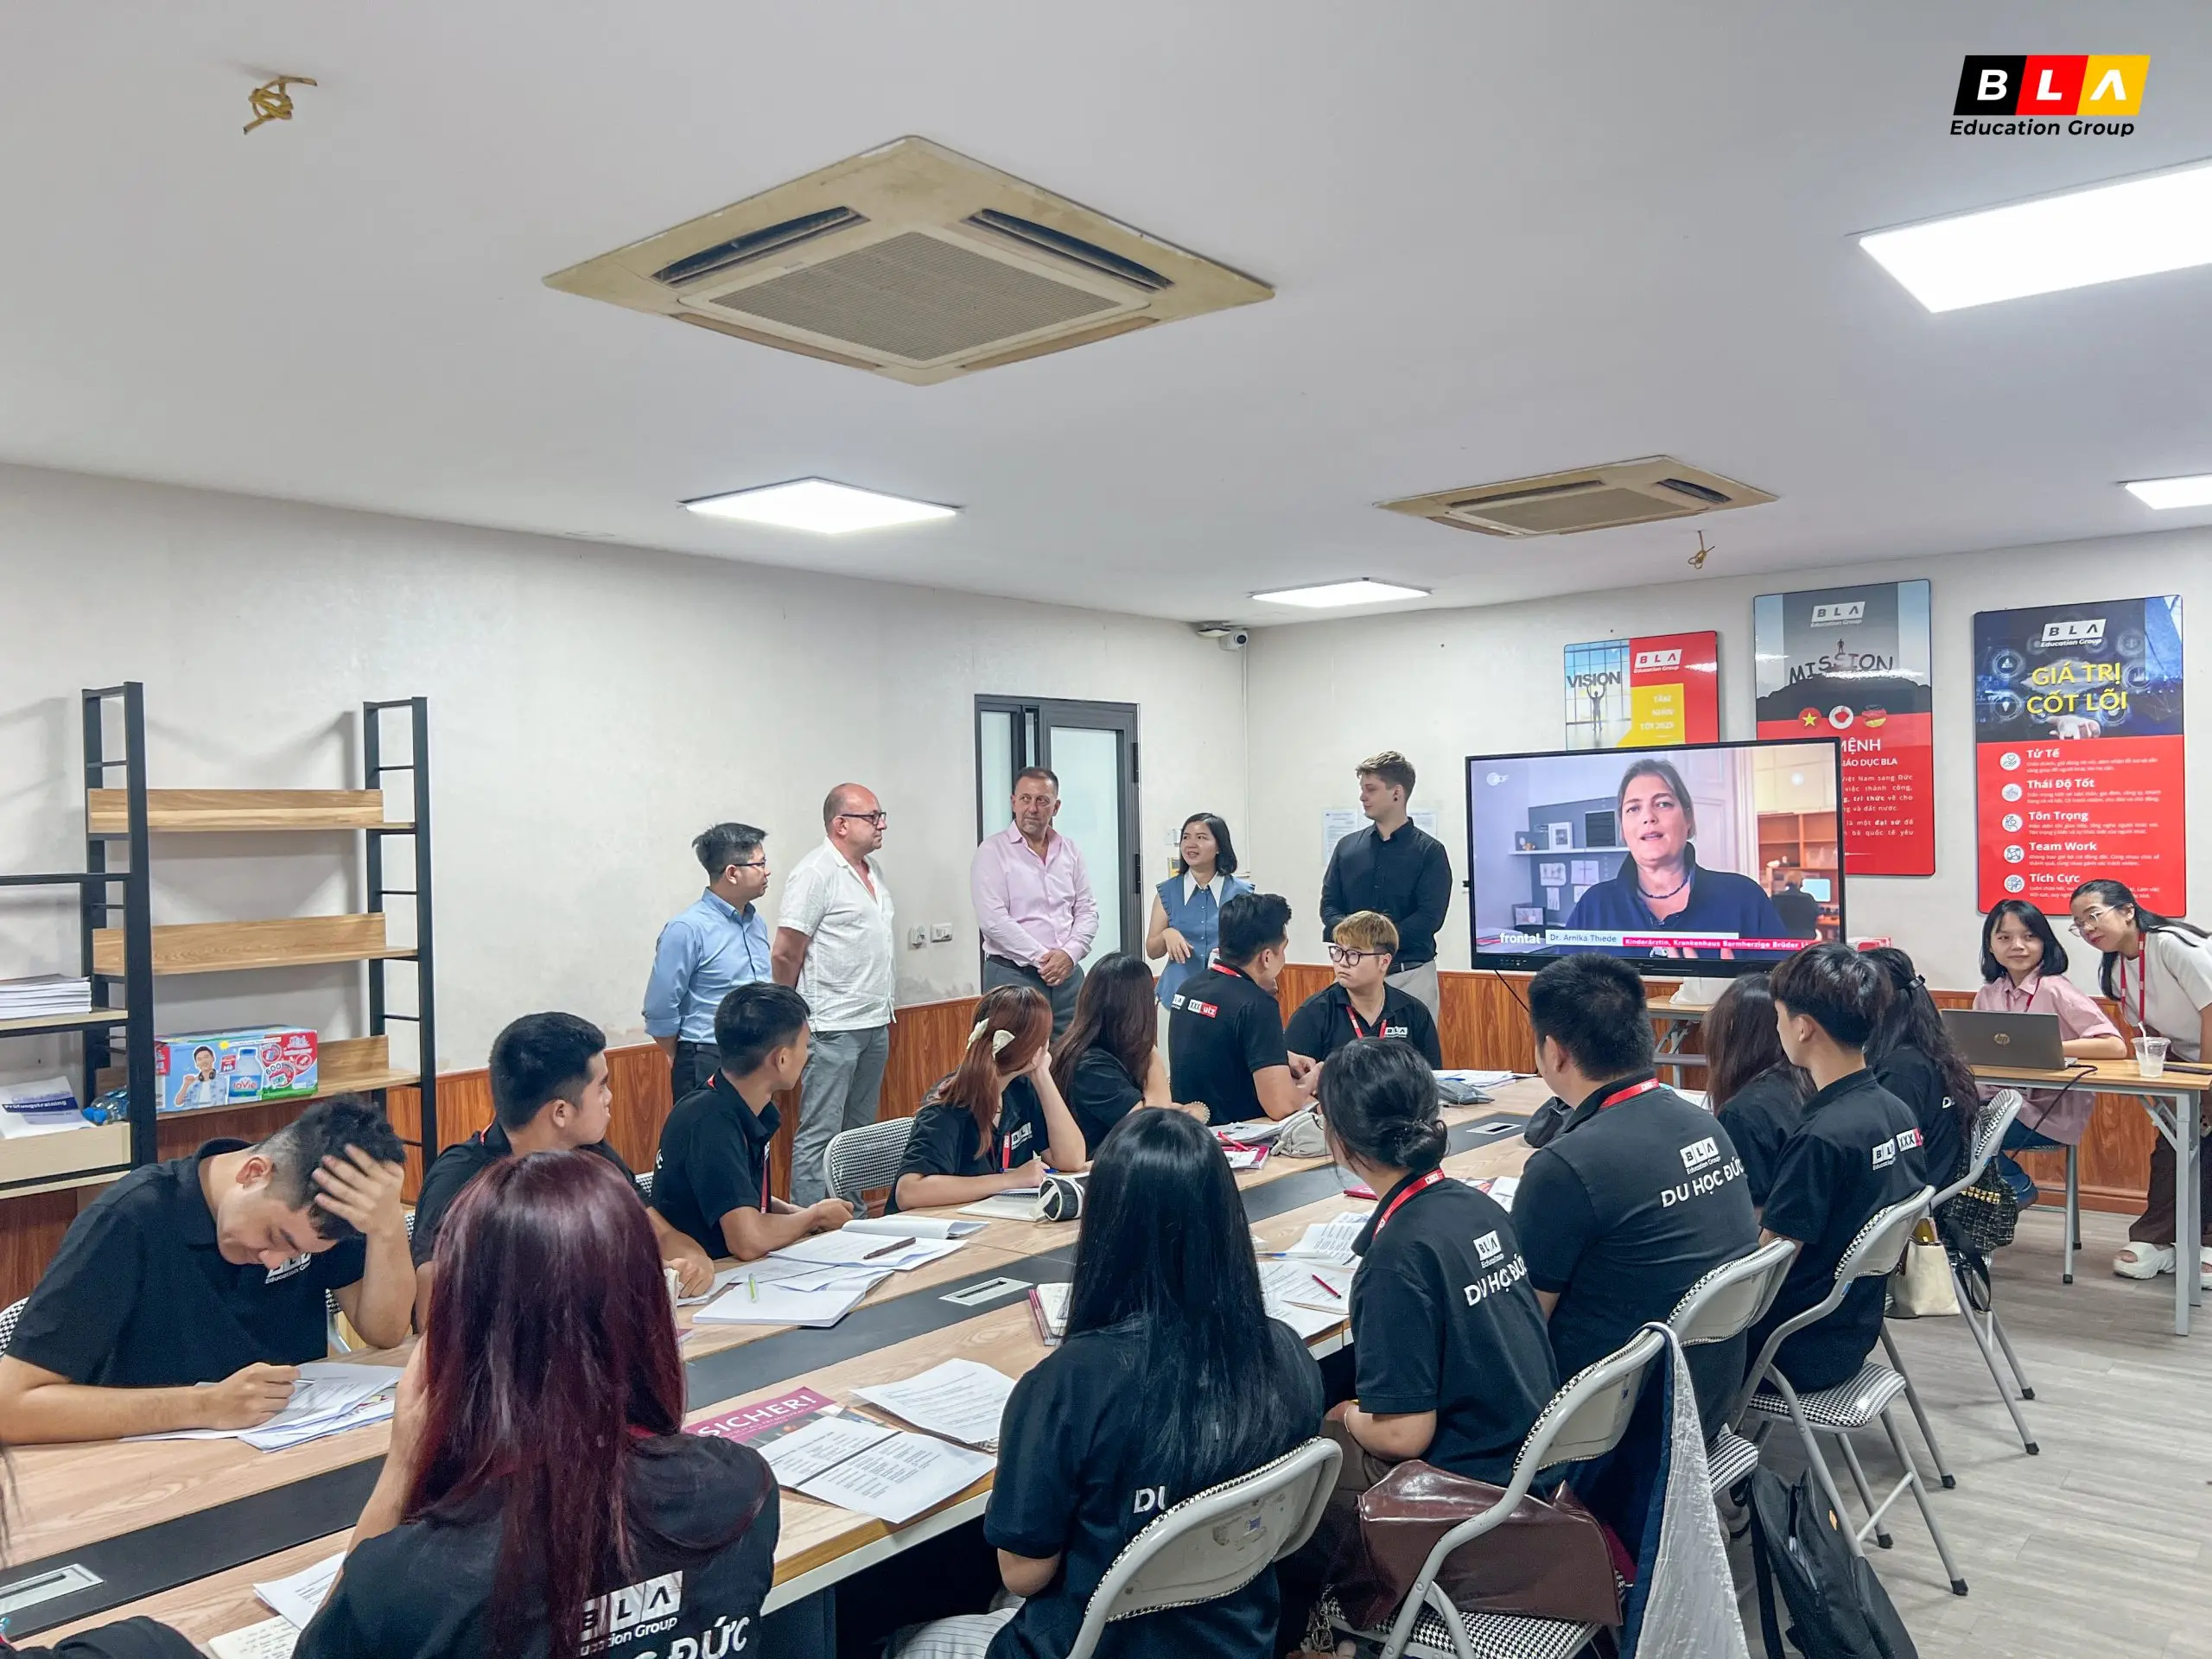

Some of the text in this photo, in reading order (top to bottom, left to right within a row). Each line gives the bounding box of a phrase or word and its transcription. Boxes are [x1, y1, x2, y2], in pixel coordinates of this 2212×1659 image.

[1817, 606, 1859, 618] BLA
[2049, 624, 2098, 637] BLA
[1640, 653, 1677, 664] BLA
[1789, 652, 1893, 685] MISSION
[2031, 660, 2122, 686] GIÁ TRỊ
[1567, 671, 1621, 688] VISION
[2026, 688, 2128, 715] CỐT LÕI
[2045, 747, 2060, 758] Tế
[1842, 758, 1859, 767] IÁO
[1860, 759, 1879, 767] DỤC
[2027, 778, 2094, 790] Thái Độ Tốt
[2029, 810, 2088, 822] Tôn Trọng
[2029, 841, 2097, 851] Team Work
[2029, 874, 2081, 885] Tích Cực
[1500, 932, 1541, 944] frontal
[1673, 939, 1720, 948] Krankenhaus
[1722, 940, 1770, 949] Barmherzige
[1685, 1142, 1715, 1162] BLA
[1686, 1155, 1721, 1175] Education Group
[1661, 1183, 1690, 1208] DU
[1691, 1170, 1724, 1197] HỌC
[264, 1268, 299, 1285] Education
[1487, 1268, 1512, 1293] HỌ
[1507, 1253, 1528, 1281] ĐỨ
[697, 1395, 817, 1437] SICHER!
[583, 1585, 672, 1631] BLA
[634, 1617, 678, 1637] Group
